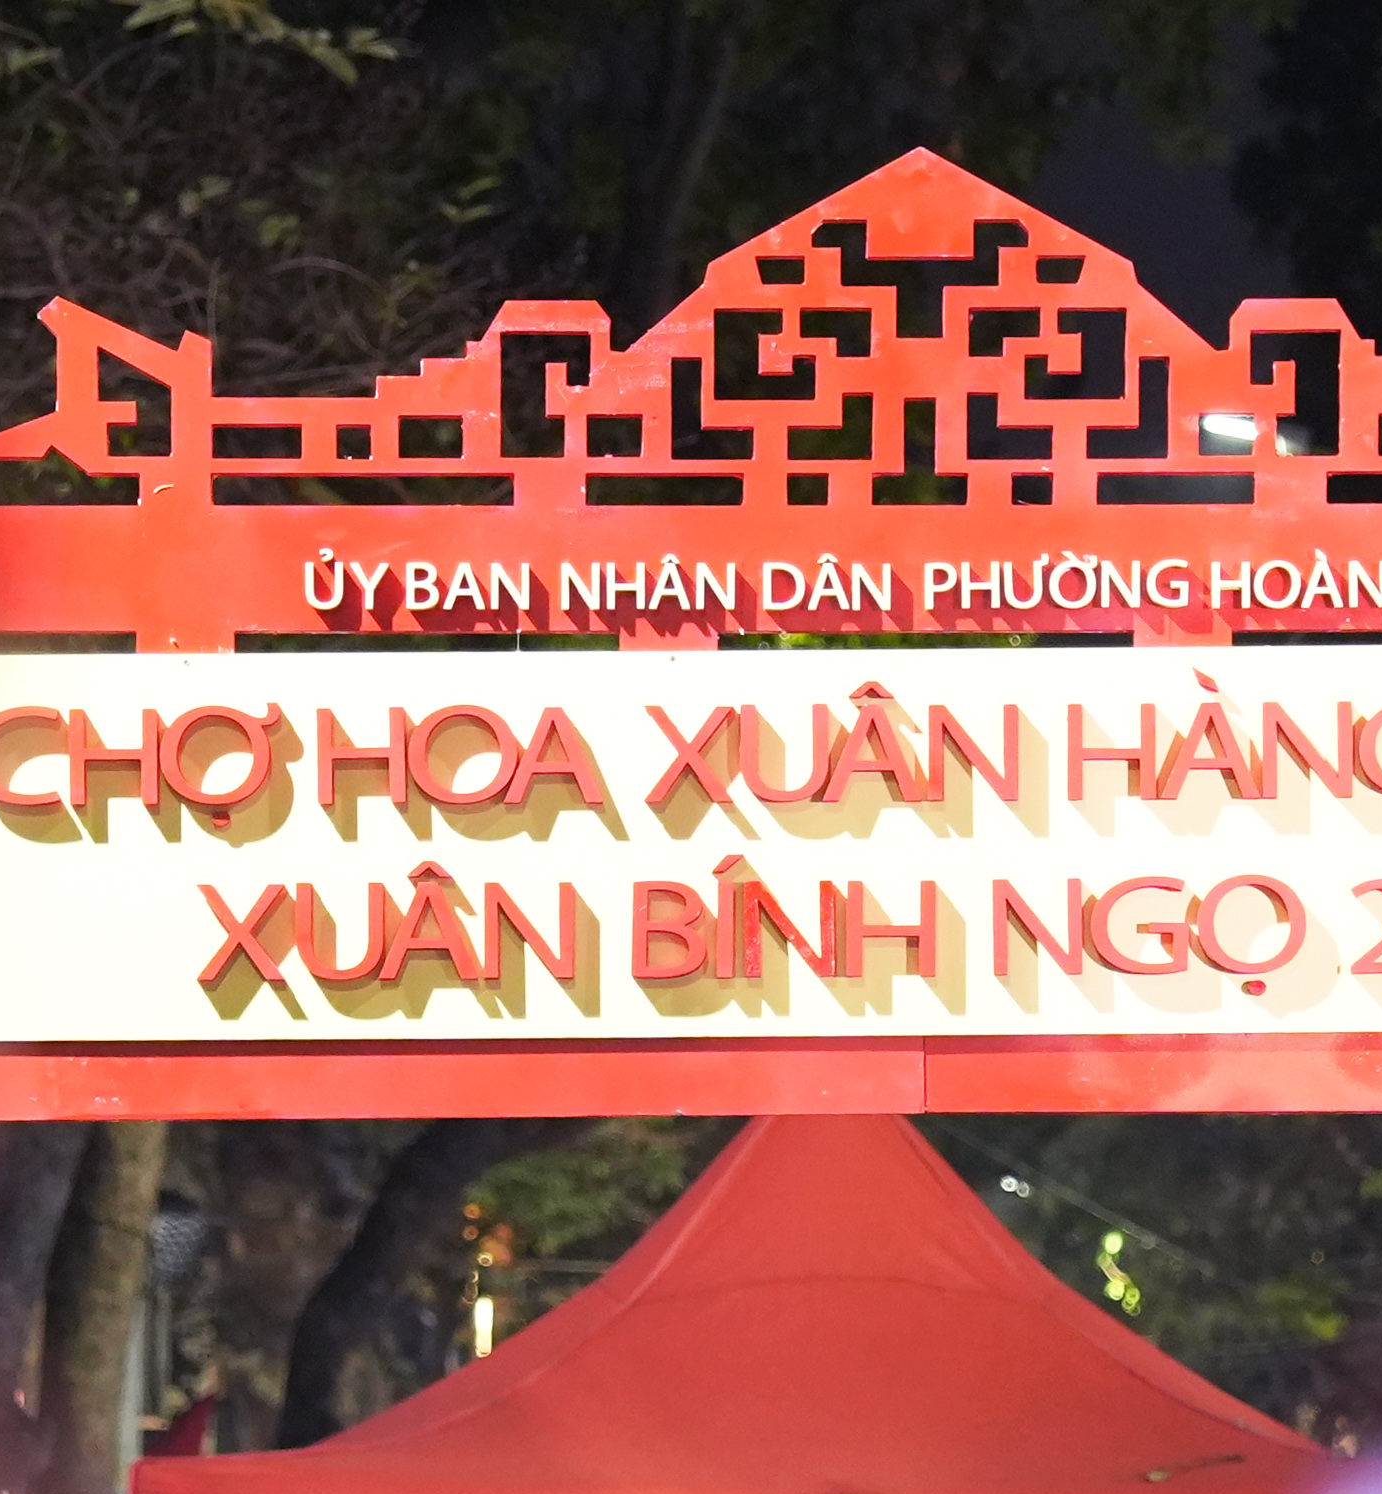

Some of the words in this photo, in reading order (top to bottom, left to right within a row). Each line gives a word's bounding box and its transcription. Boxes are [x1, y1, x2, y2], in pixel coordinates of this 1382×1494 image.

[407, 561, 531, 612] BAN
[560, 553, 737, 612] NHÂN
[762, 553, 893, 612] DÂN
[923, 550, 1189, 611] PHƯỜNG
[317, 703, 605, 807] HOA
[644, 680, 1019, 806] XUÂN
[196, 859, 577, 984] XUÂN
[631, 853, 937, 982] BÍNH
[992, 873, 1308, 997] NGỌ
